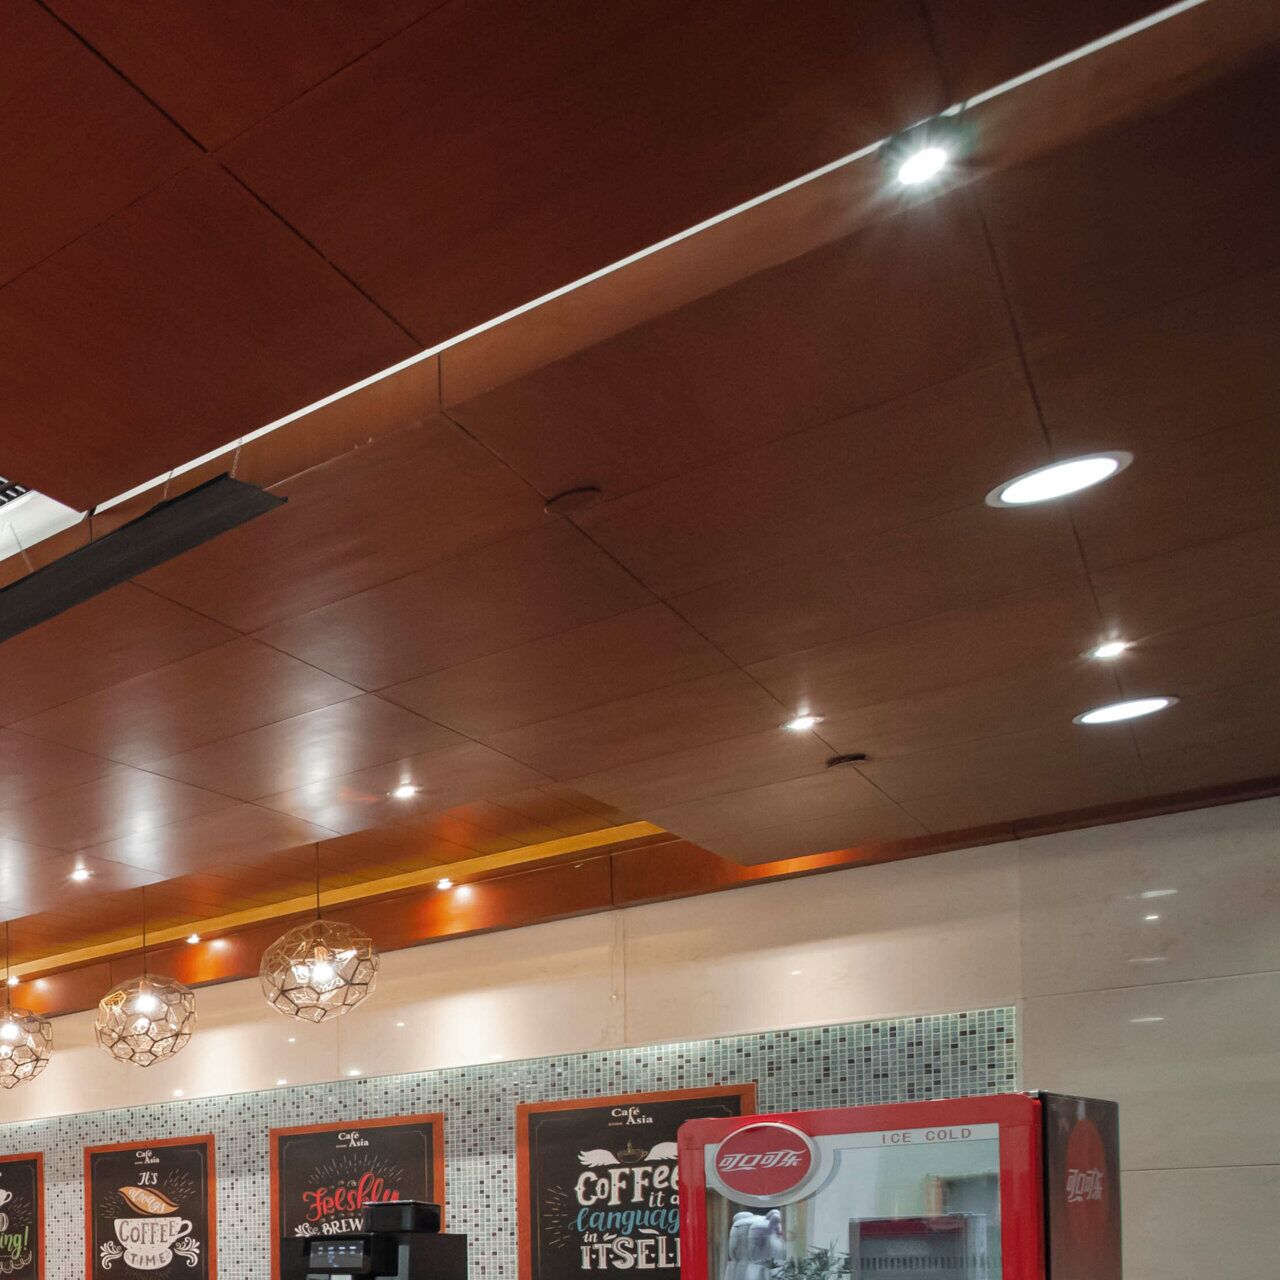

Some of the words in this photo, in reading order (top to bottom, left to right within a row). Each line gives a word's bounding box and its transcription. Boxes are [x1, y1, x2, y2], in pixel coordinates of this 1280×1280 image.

[611, 1106, 640, 1117] Café
[626, 1115, 653, 1125] Asia
[338, 1131, 360, 1140] Café
[882, 1131, 912, 1144] ICE
[925, 1128, 972, 1141] COLD
[349, 1139, 369, 1147] Asia
[135, 1149, 153, 1158] Café
[719, 1148, 807, 1172] 可口可乐
[648, 1191, 665, 1208] it
[583, 1231, 598, 1243] in
[130, 1253, 166, 1266] TIME
